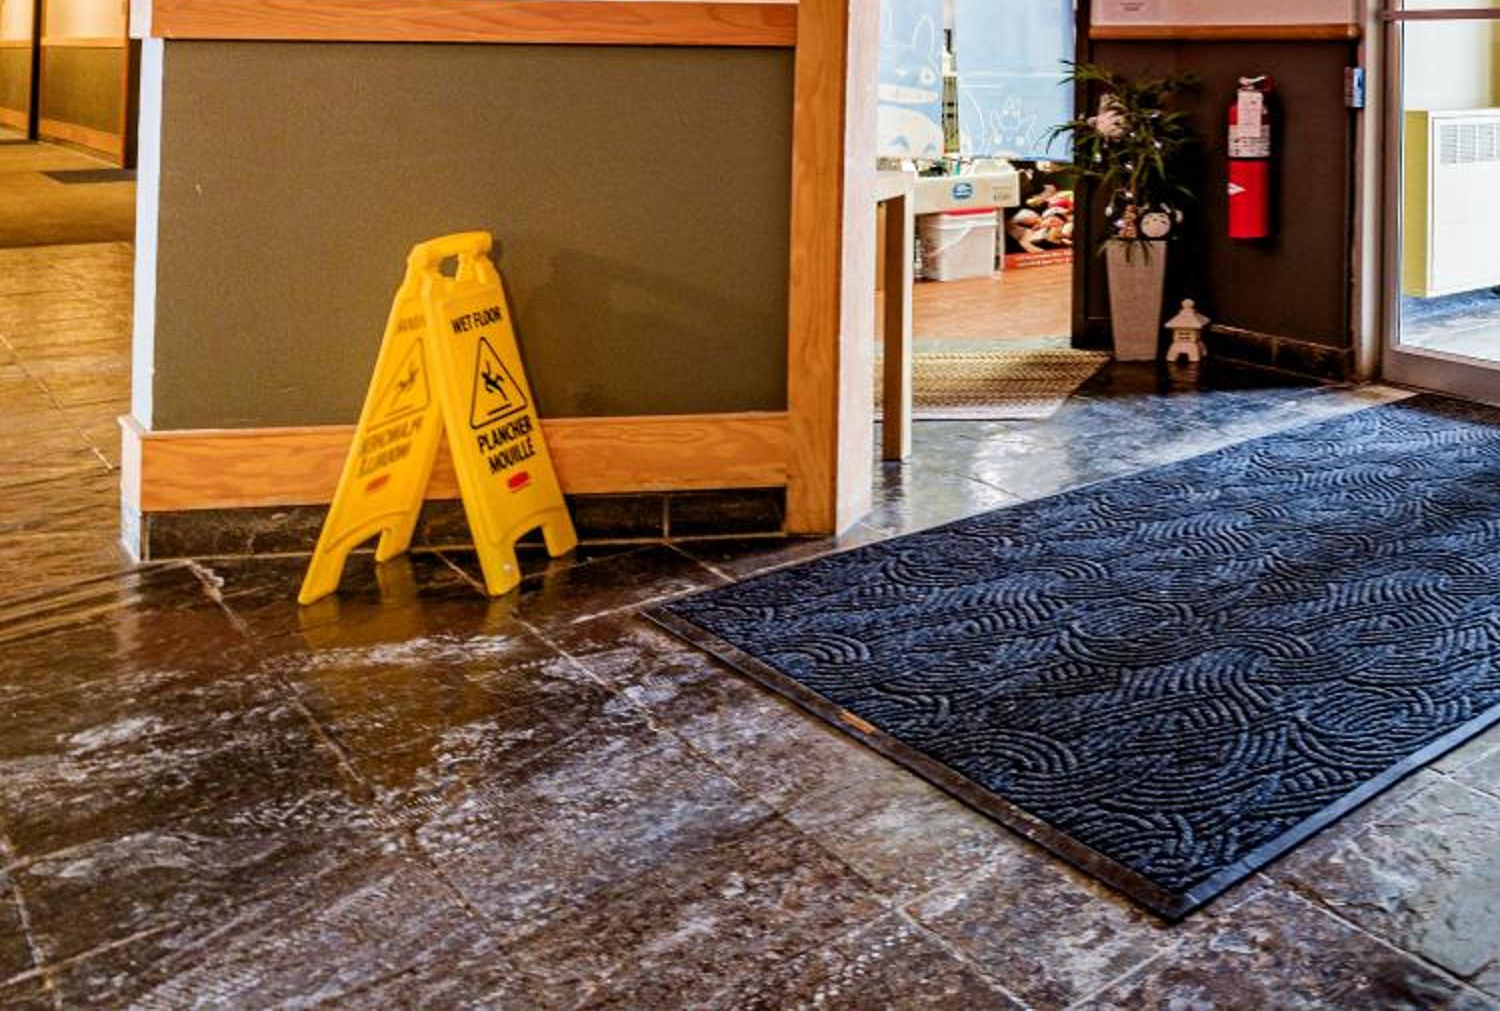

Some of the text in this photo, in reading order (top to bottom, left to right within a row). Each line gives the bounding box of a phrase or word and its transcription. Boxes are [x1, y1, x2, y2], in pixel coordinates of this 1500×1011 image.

[451, 315, 473, 334] WET
[473, 305, 502, 328] FLOOR
[477, 414, 534, 455] PLANCHER
